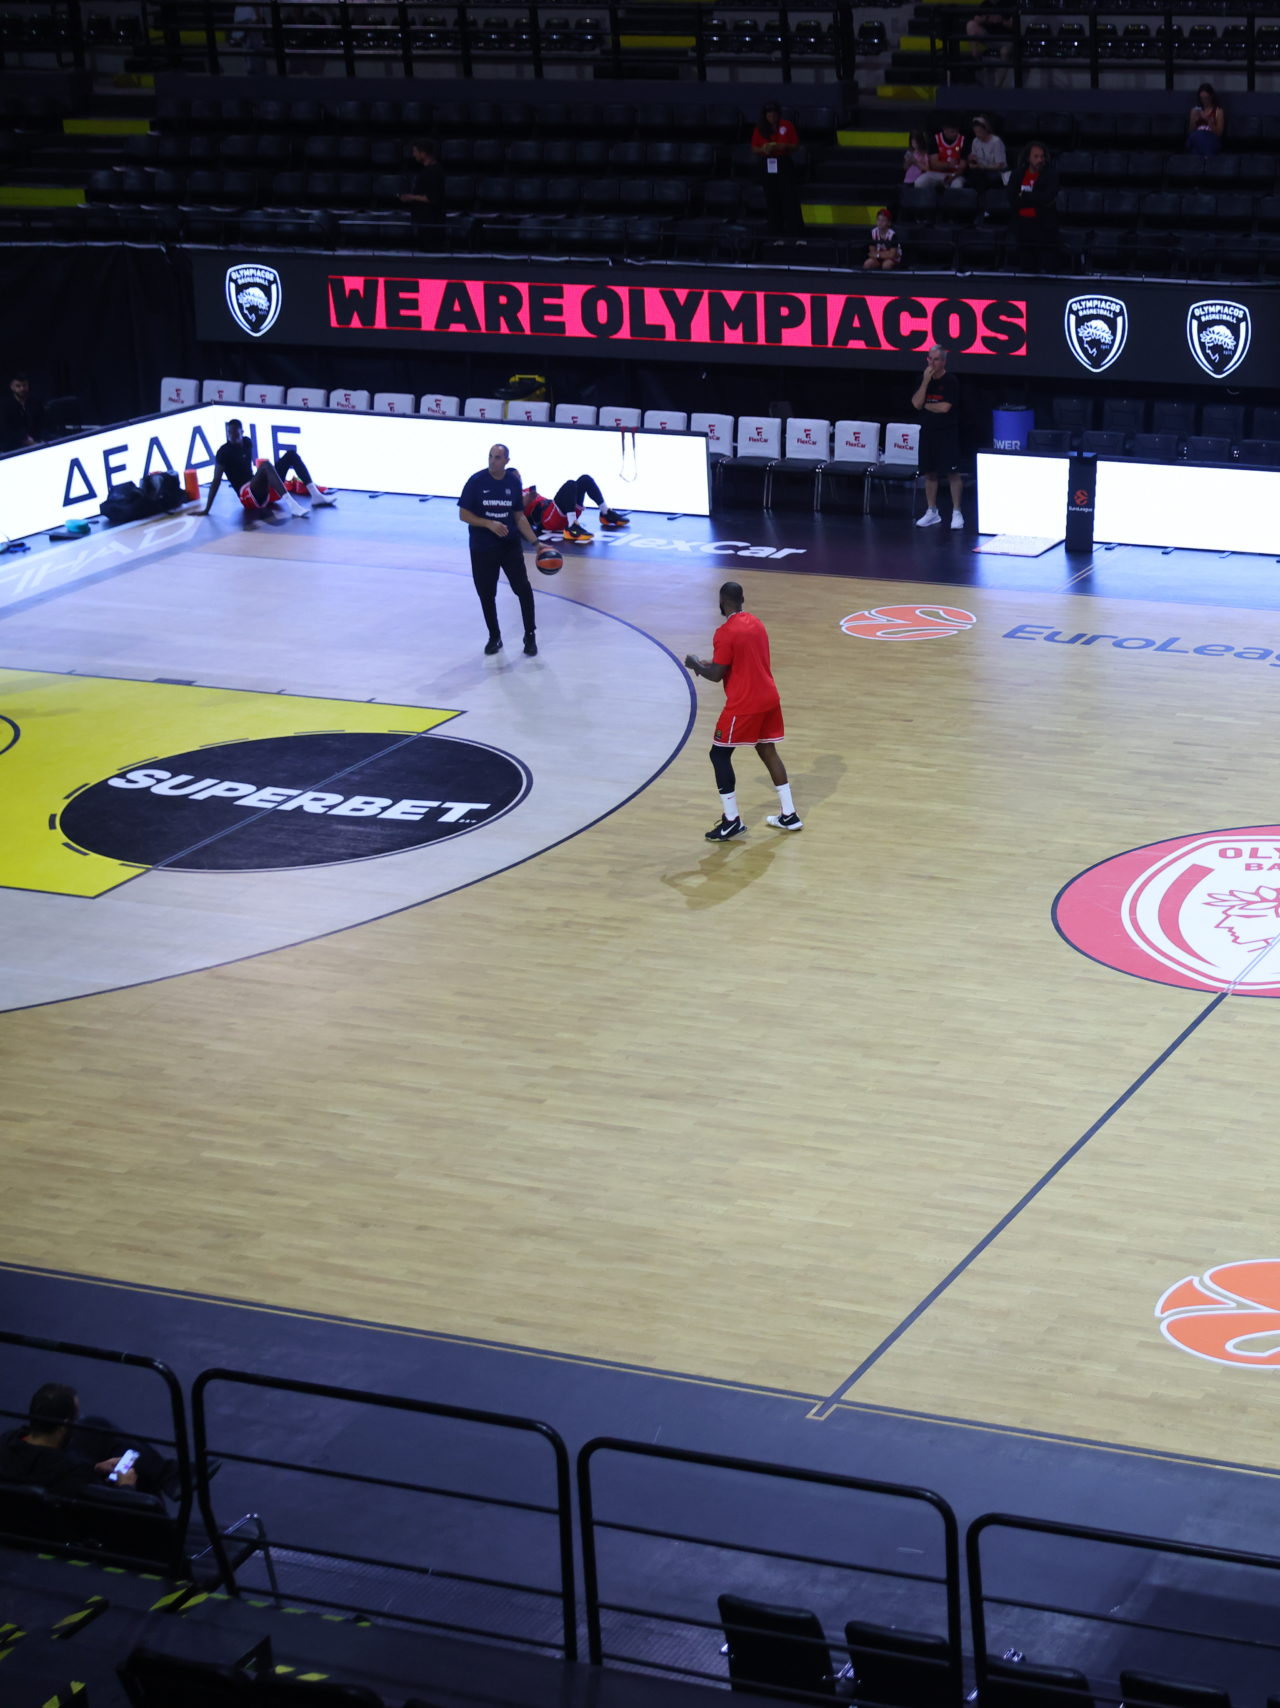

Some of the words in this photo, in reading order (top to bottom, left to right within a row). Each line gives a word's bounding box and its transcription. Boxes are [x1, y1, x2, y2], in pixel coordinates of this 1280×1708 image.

[329, 276, 422, 328] WE
[434, 280, 566, 336] ARE
[580, 285, 1027, 355] OLYMPIACOS
[1071, 299, 1121, 313] OLYMPIACOS
[1193, 305, 1245, 319] OLYMPIACOS
[107, 768, 491, 823] SUPERBET
